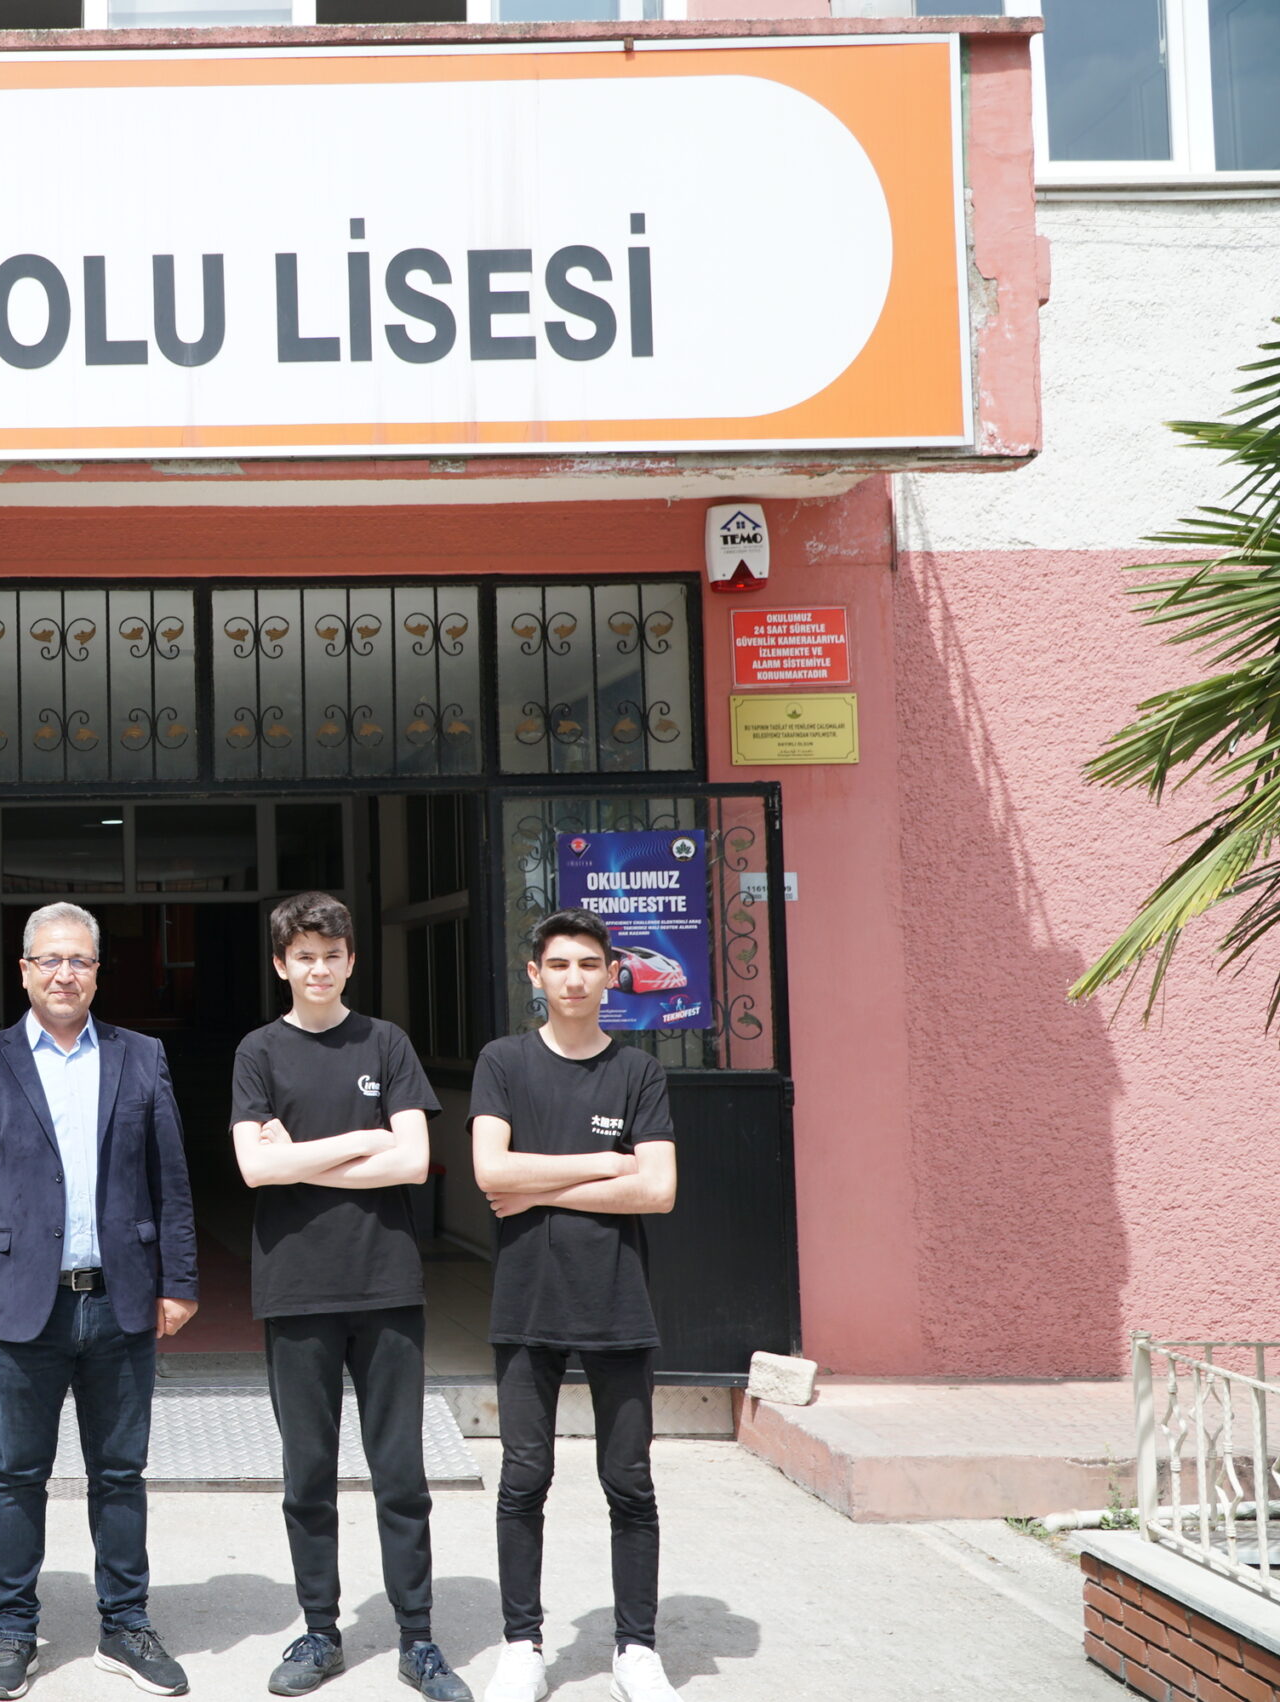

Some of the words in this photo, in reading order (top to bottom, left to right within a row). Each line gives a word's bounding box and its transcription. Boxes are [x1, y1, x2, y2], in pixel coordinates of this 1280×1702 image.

[275, 212, 654, 364] LİSESİ
[767, 613, 812, 623] OKULUMUZ
[754, 626, 764, 635] 24
[767, 625, 787, 634] SAAT
[789, 623, 825, 634] SÜREYLE
[736, 636, 776, 646] GÜVENLİK
[778, 634, 845, 645] KAMERALARIYLA
[759, 647, 810, 657] İZLENMEKTE
[812, 647, 823, 656] VE
[752, 660, 780, 669] ALARM
[783, 657, 831, 668] SİSTEMİYLE
[757, 669, 828, 680] KORUNMAKTADIR
[587, 870, 680, 891] OKULUMUZ
[581, 896, 687, 914] TEKNOFEST'TE
[662, 1006, 701, 1023] TEKNOFEST
